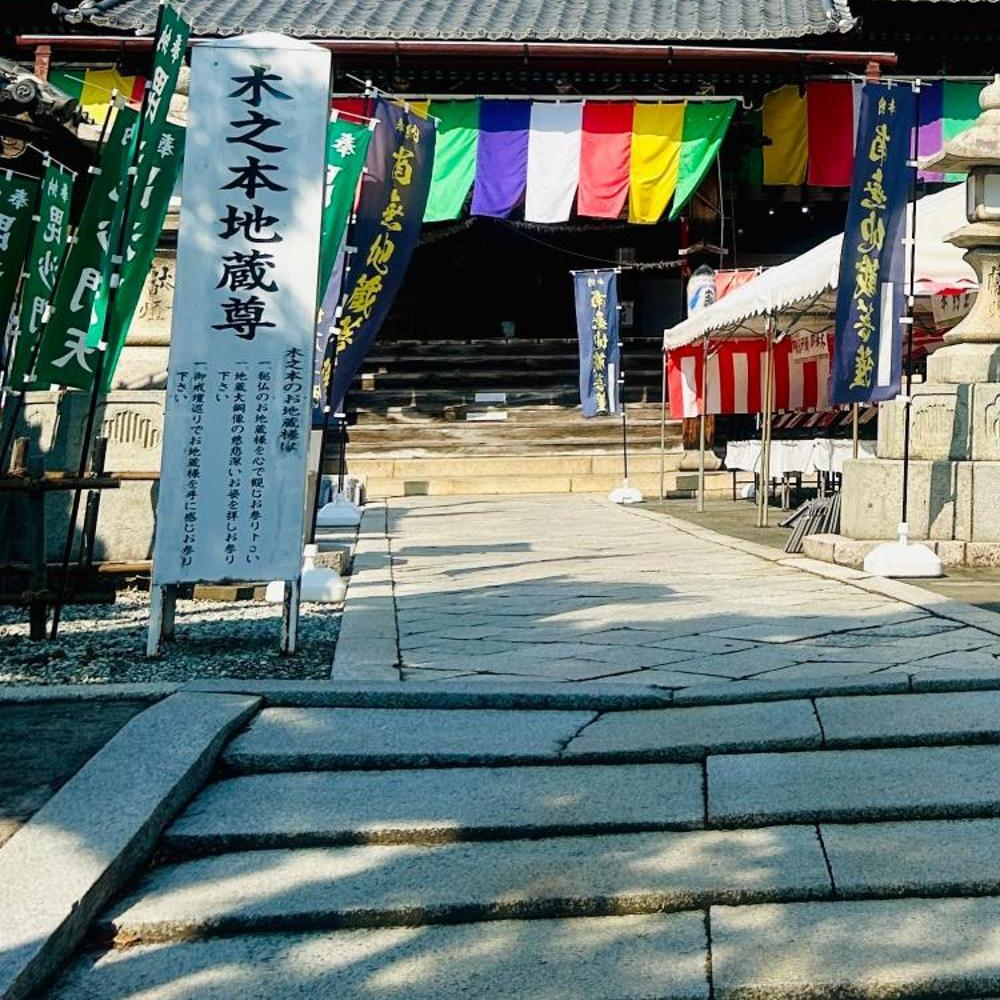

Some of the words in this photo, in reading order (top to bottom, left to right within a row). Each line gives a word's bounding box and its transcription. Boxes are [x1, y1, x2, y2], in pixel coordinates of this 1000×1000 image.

[211, 65, 293, 342] 木之本地蔵尊
[174, 371, 189, 403] 下さい
[215, 371, 231, 403] 下さい
[278, 347, 305, 453] 木之本のお地蔵様は
